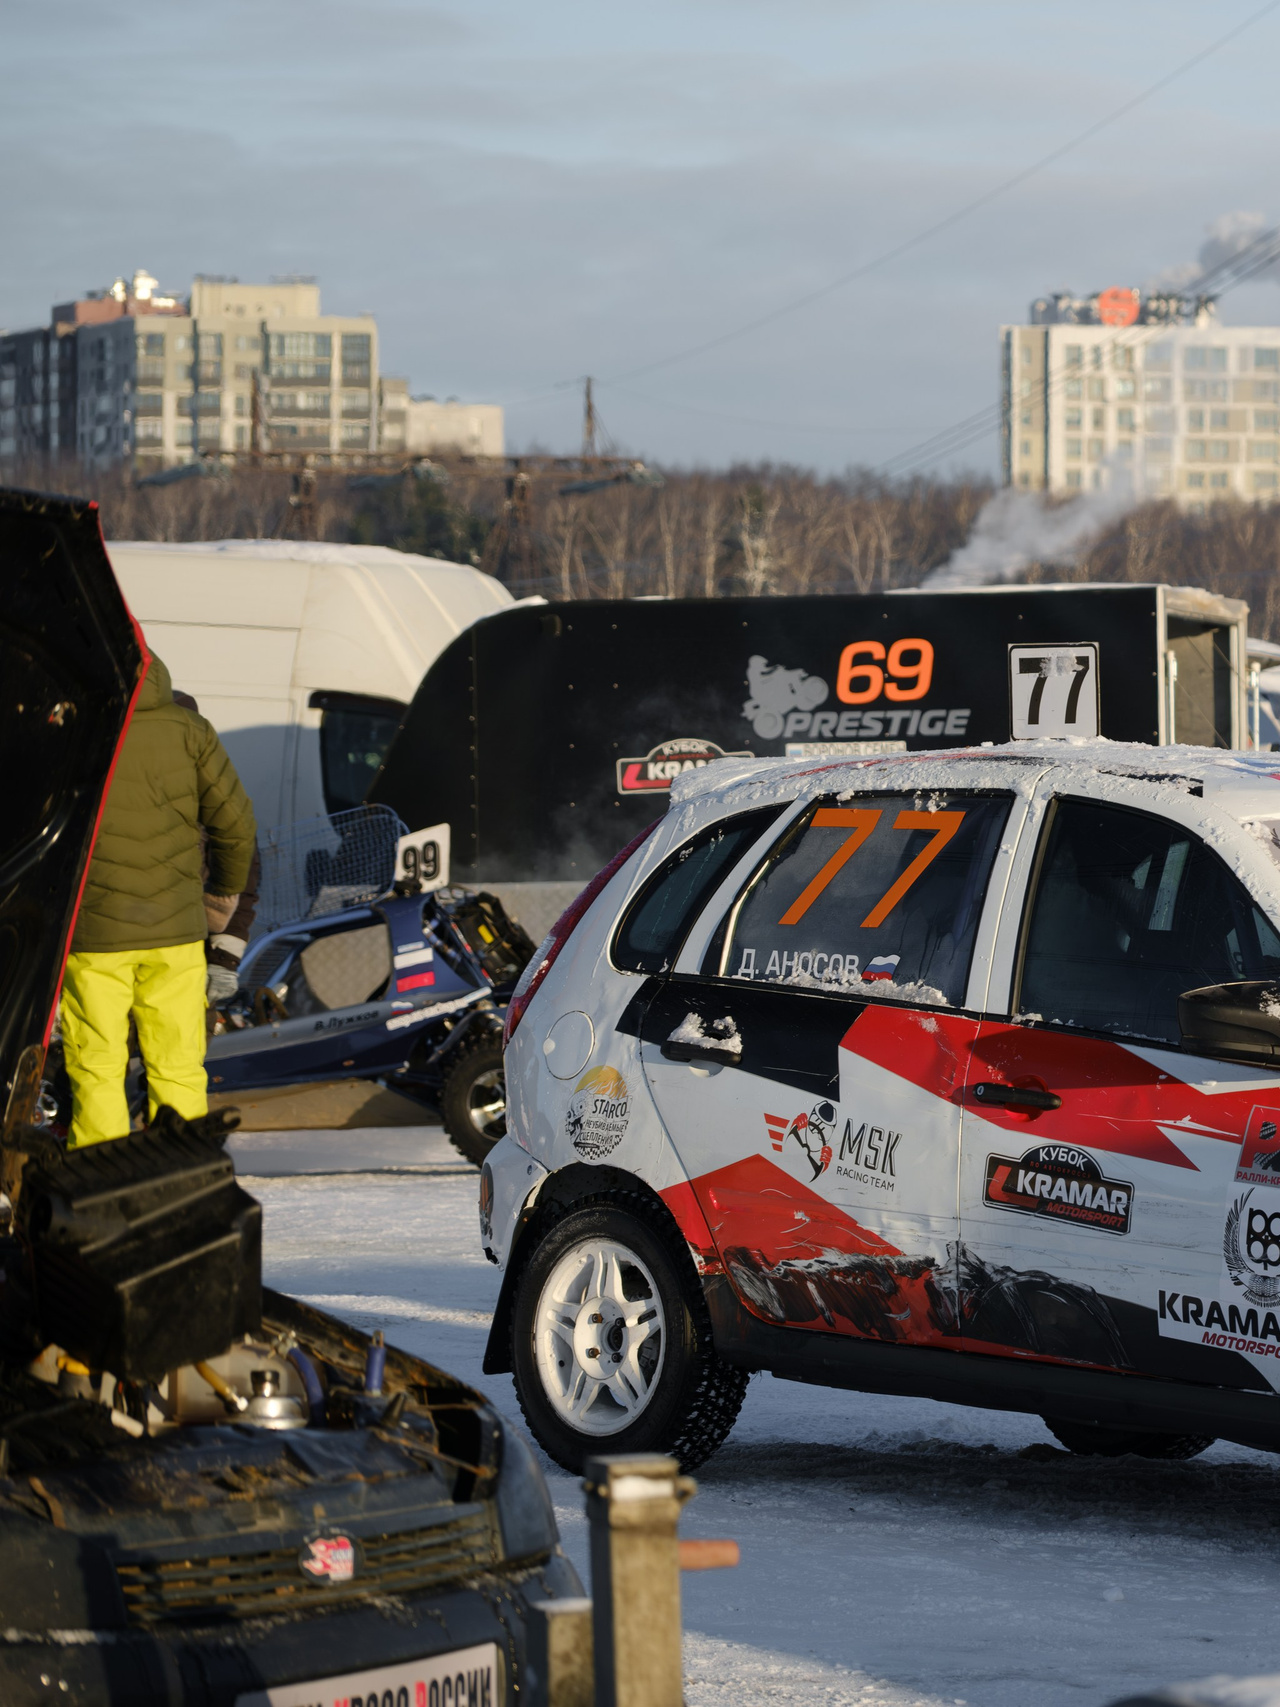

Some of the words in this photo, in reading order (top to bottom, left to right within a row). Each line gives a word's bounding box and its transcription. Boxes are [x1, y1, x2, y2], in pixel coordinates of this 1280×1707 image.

[836, 638, 934, 704] 69
[1019, 656, 1089, 725] 77
[782, 709, 971, 738] PRESTIGE
[402, 840, 440, 881] 99
[778, 808, 966, 928] 77
[765, 950, 860, 980] АНОСОВ
[592, 1099, 627, 1119] STARCO
[580, 1131, 614, 1146] СЦЕПЛЕНИЯ
[585, 1118, 625, 1132] НЕУБИВАЕМЫЕ
[839, 1117, 902, 1177] MSK
[1039, 1147, 1088, 1171] КУБОК
[836, 1165, 869, 1184] RACING
[870, 1176, 895, 1192] TEAM
[1016, 1169, 1128, 1216] KRAMAR
[1046, 1202, 1126, 1228] MOTORSPORT
